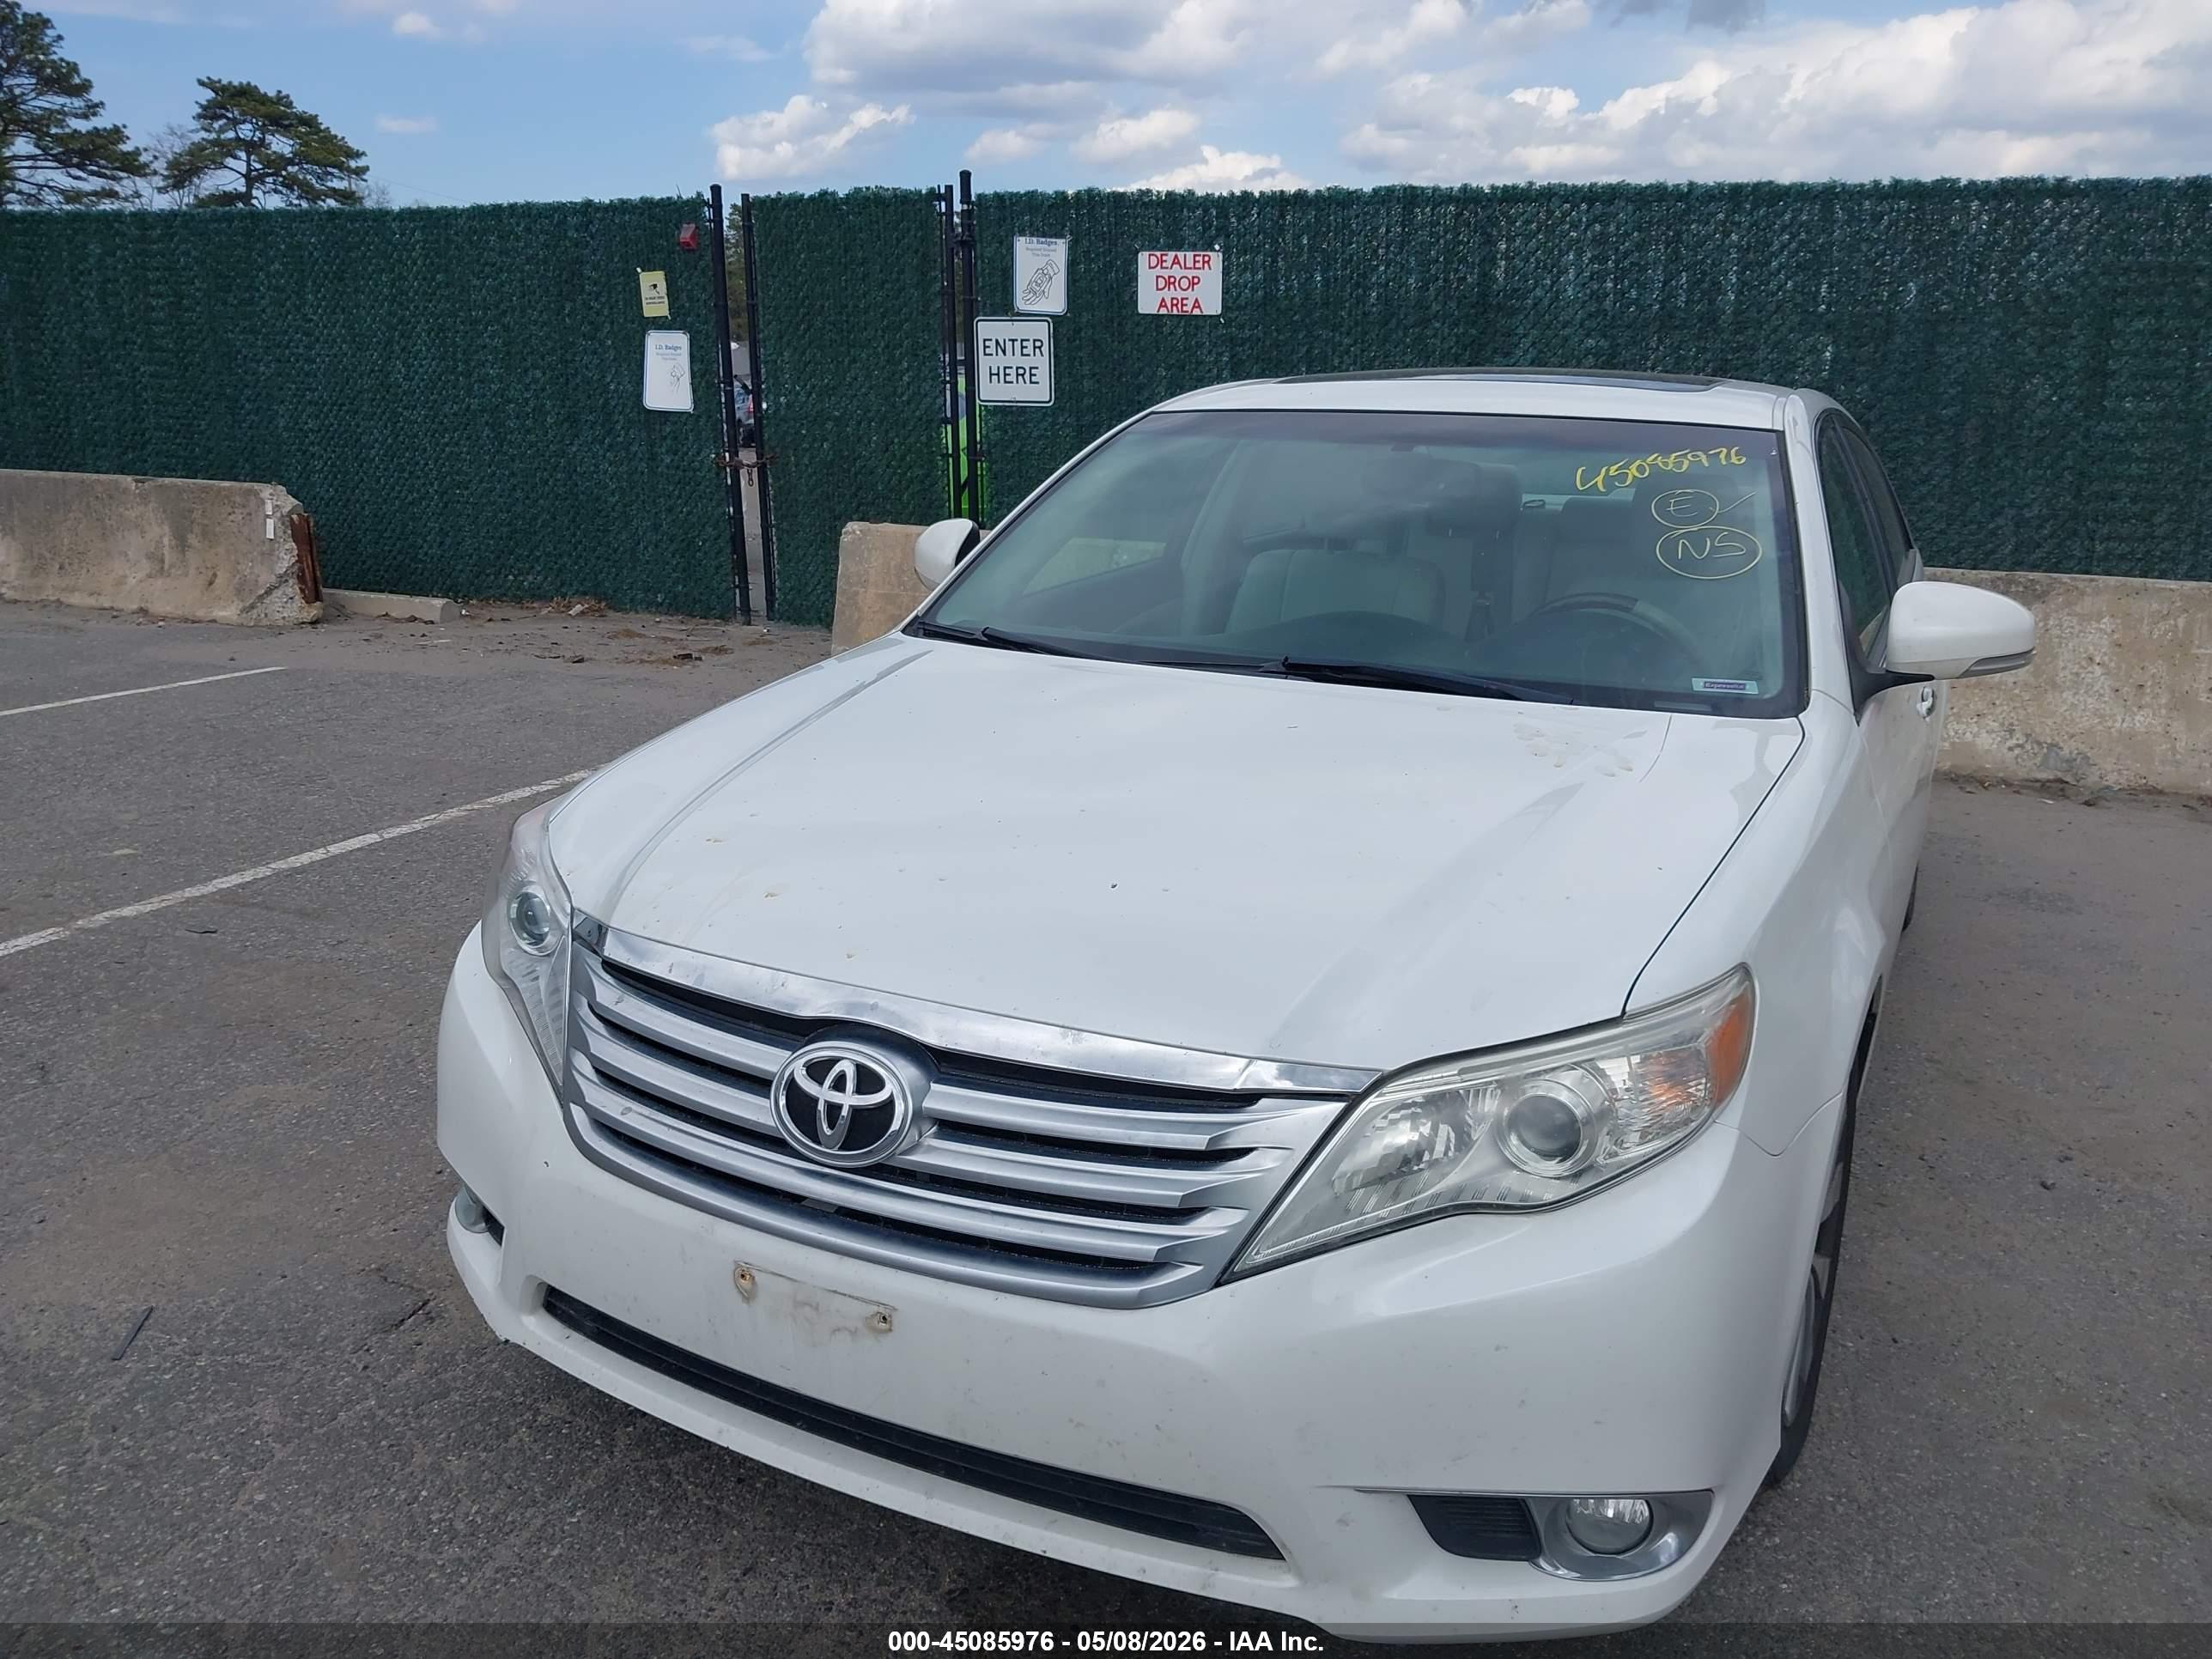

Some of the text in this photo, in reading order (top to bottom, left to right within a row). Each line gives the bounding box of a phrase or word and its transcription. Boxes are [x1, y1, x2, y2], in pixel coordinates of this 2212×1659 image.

[1036, 239, 1057, 247] Badges
[1147, 253, 1212, 270] DEALER
[1155, 275, 1201, 292] DROP
[1156, 297, 1204, 314] AREA
[982, 337, 1044, 357] ENTER
[988, 365, 1040, 385] HERE
[1576, 447, 1747, 491] 45085976
[1666, 496, 1698, 517] E
[1678, 532, 1746, 560] NS
